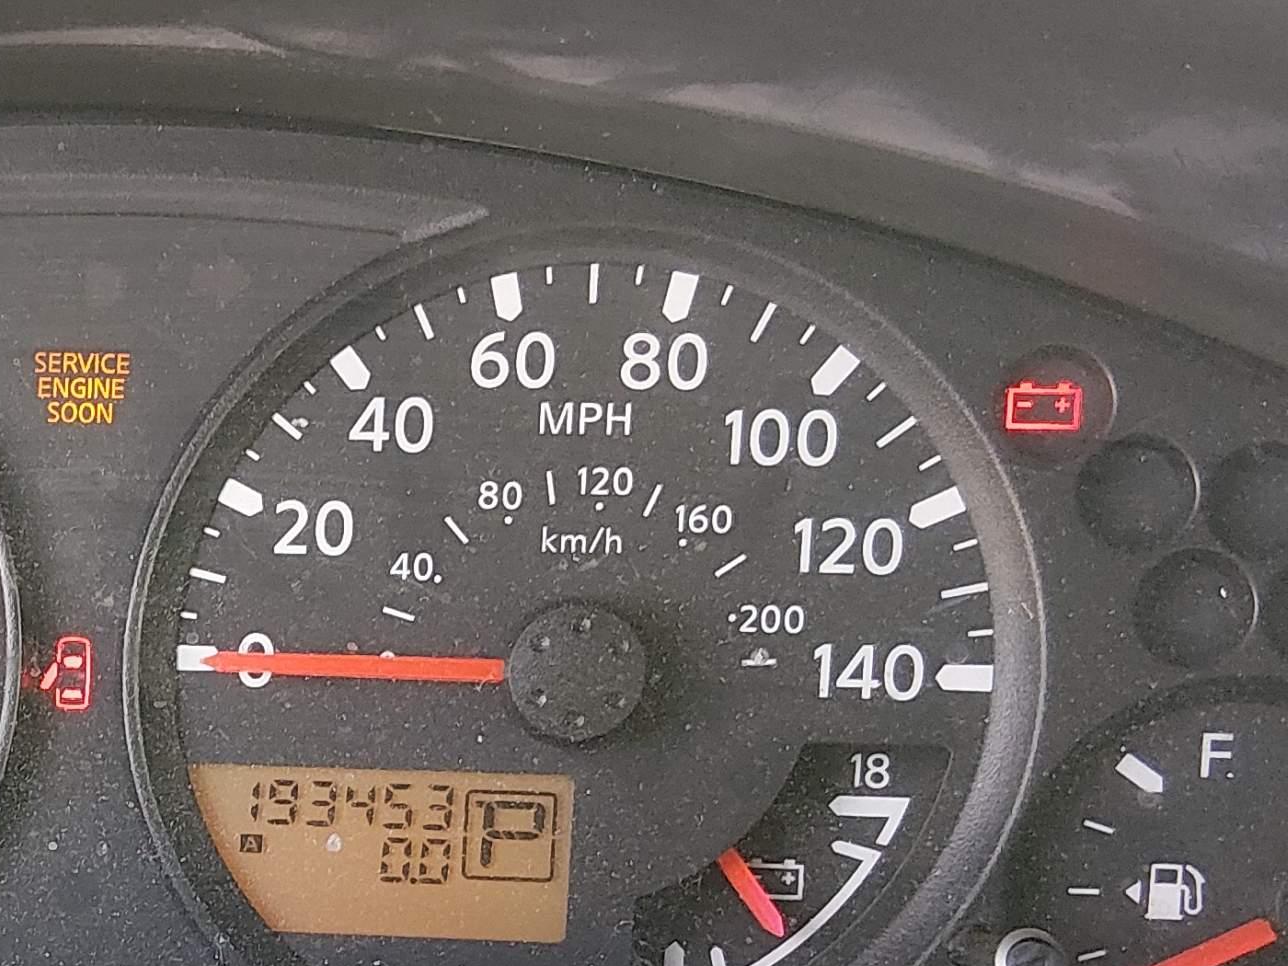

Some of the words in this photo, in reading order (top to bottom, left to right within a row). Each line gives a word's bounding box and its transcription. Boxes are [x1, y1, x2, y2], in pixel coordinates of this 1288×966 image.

[34, 351, 131, 375] SERVICE
[470, 331, 555, 388] 60
[620, 332, 708, 390] 80
[38, 376, 125, 399] ENGINE
[47, 401, 113, 424] SOON
[349, 396, 434, 453] 40
[538, 402, 633, 436] MPH
[724, 408, 838, 466] 100
[479, 480, 523, 510] 80
[577, 466, 634, 496] 120
[273, 500, 353, 555] 20
[541, 526, 623, 555] km/h
[675, 504, 733, 534] 160
[794, 517, 904, 576] 120
[739, 604, 805, 634] 200
[238, 633, 275, 688] 0
[813, 643, 924, 701] 140
[850, 753, 890, 789] 18
[1201, 732, 1234, 778] F
[251, 779, 454, 829] 193453
[475, 800, 546, 868] P
[380, 837, 451, 884] 0.0
